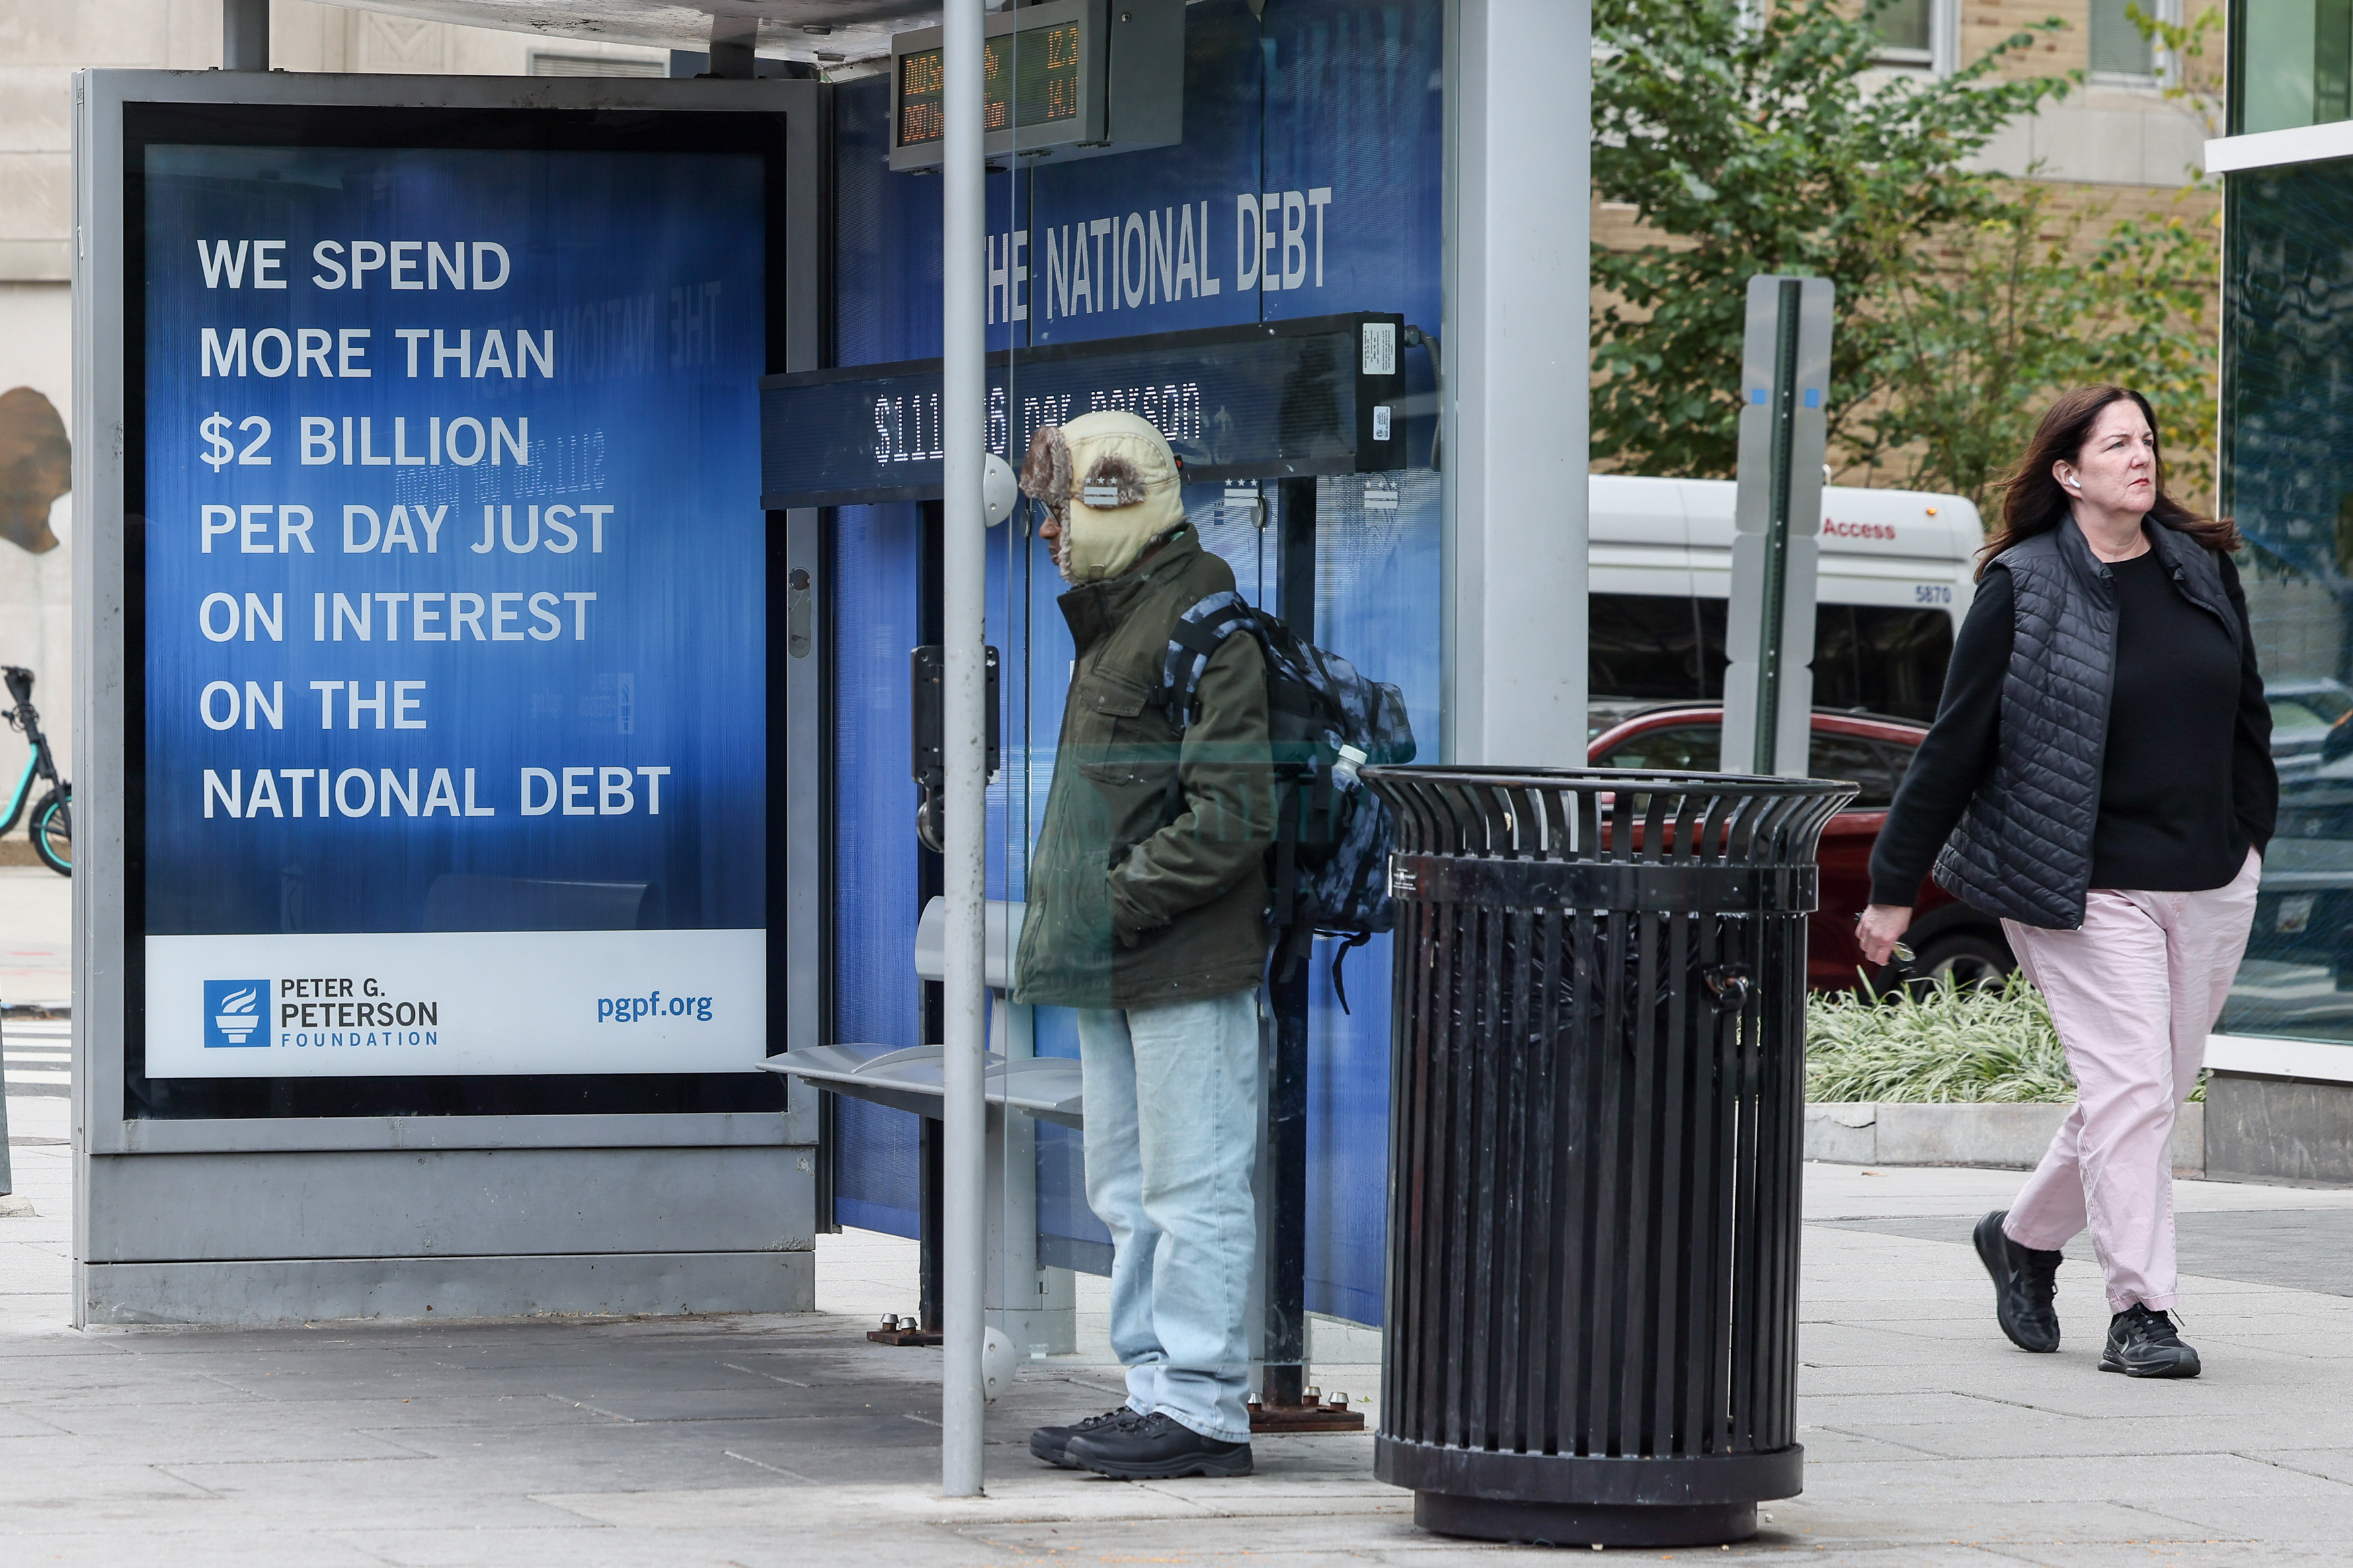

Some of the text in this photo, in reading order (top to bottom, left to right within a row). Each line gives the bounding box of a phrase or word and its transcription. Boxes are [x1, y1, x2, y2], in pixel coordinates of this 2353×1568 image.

[197, 240, 510, 290] WE SPEND
[985, 187, 1331, 325] HE NATIONAL DEBT
[202, 328, 553, 378] MORE THAN
[200, 412, 528, 472] $2 BILLION
[202, 505, 614, 553] PER DAY JUST
[1823, 518, 1896, 540] Access
[200, 592, 597, 642] ON INTEREST
[1916, 585, 1952, 604] 5870
[200, 680, 426, 730] ON THE
[204, 766, 671, 818] NATIONAL DEBT
[282, 978, 385, 998] PETER G.
[598, 991, 713, 1023] pgpf.org
[282, 1001, 438, 1028] PETERSON
[282, 1031, 438, 1047] FOUNDATION
